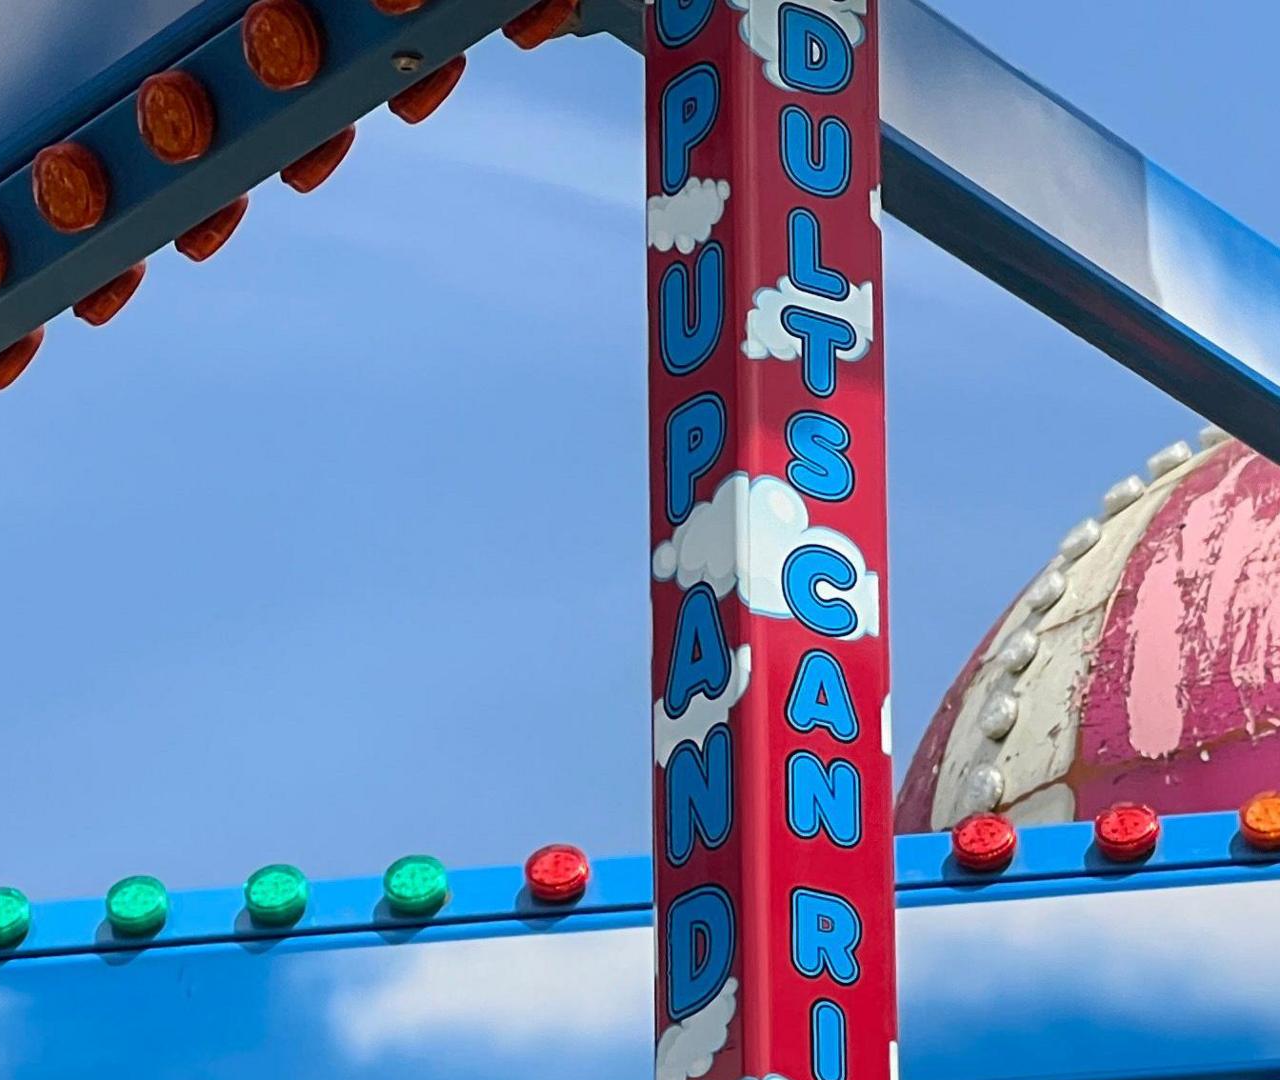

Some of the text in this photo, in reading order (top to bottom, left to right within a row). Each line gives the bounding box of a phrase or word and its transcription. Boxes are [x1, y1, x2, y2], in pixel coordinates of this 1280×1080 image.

[660, 241, 725, 525] UP
[779, 0, 857, 502] DULTS
[665, 581, 736, 1022] AND
[782, 544, 860, 847] CAN
